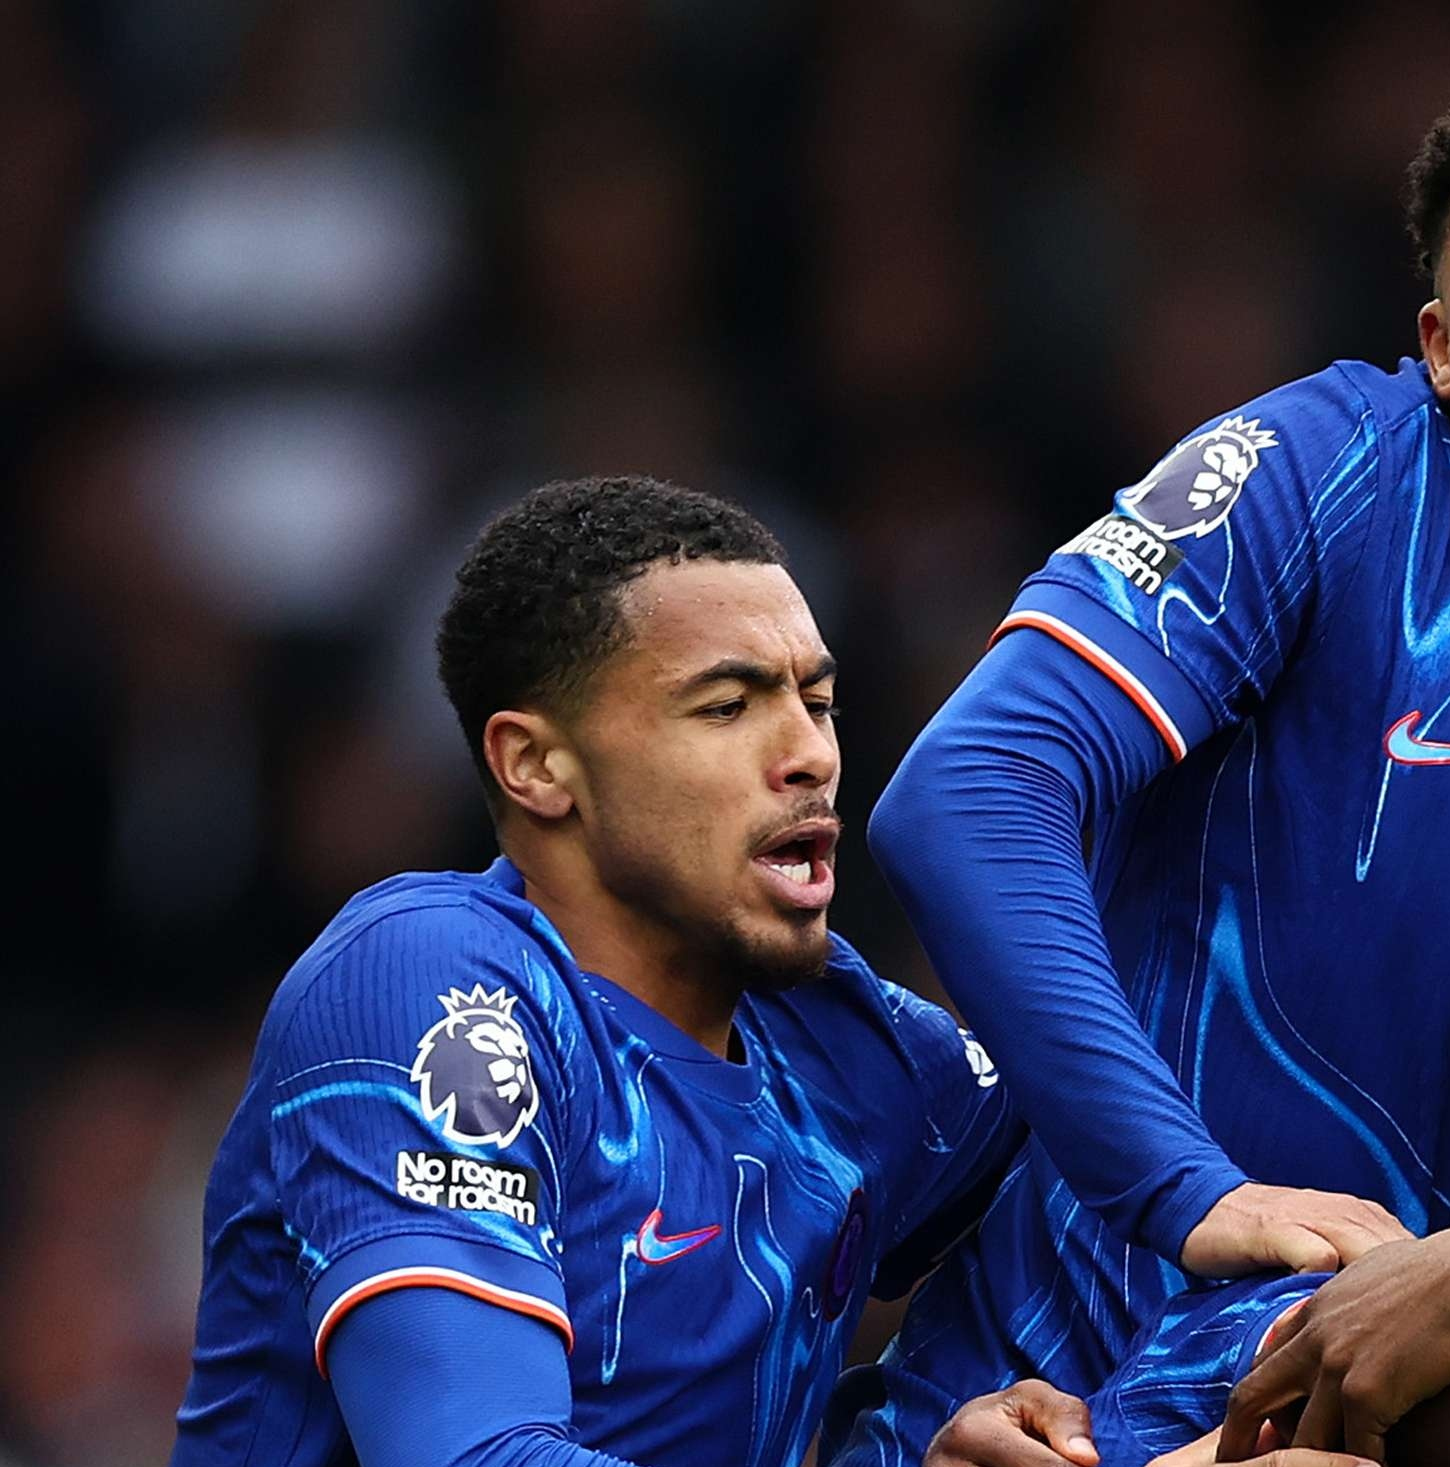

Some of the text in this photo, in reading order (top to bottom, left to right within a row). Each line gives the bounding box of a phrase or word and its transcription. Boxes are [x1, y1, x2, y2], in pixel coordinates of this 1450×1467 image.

[397, 1151, 527, 1198] No room
[397, 1176, 536, 1226] for racm
